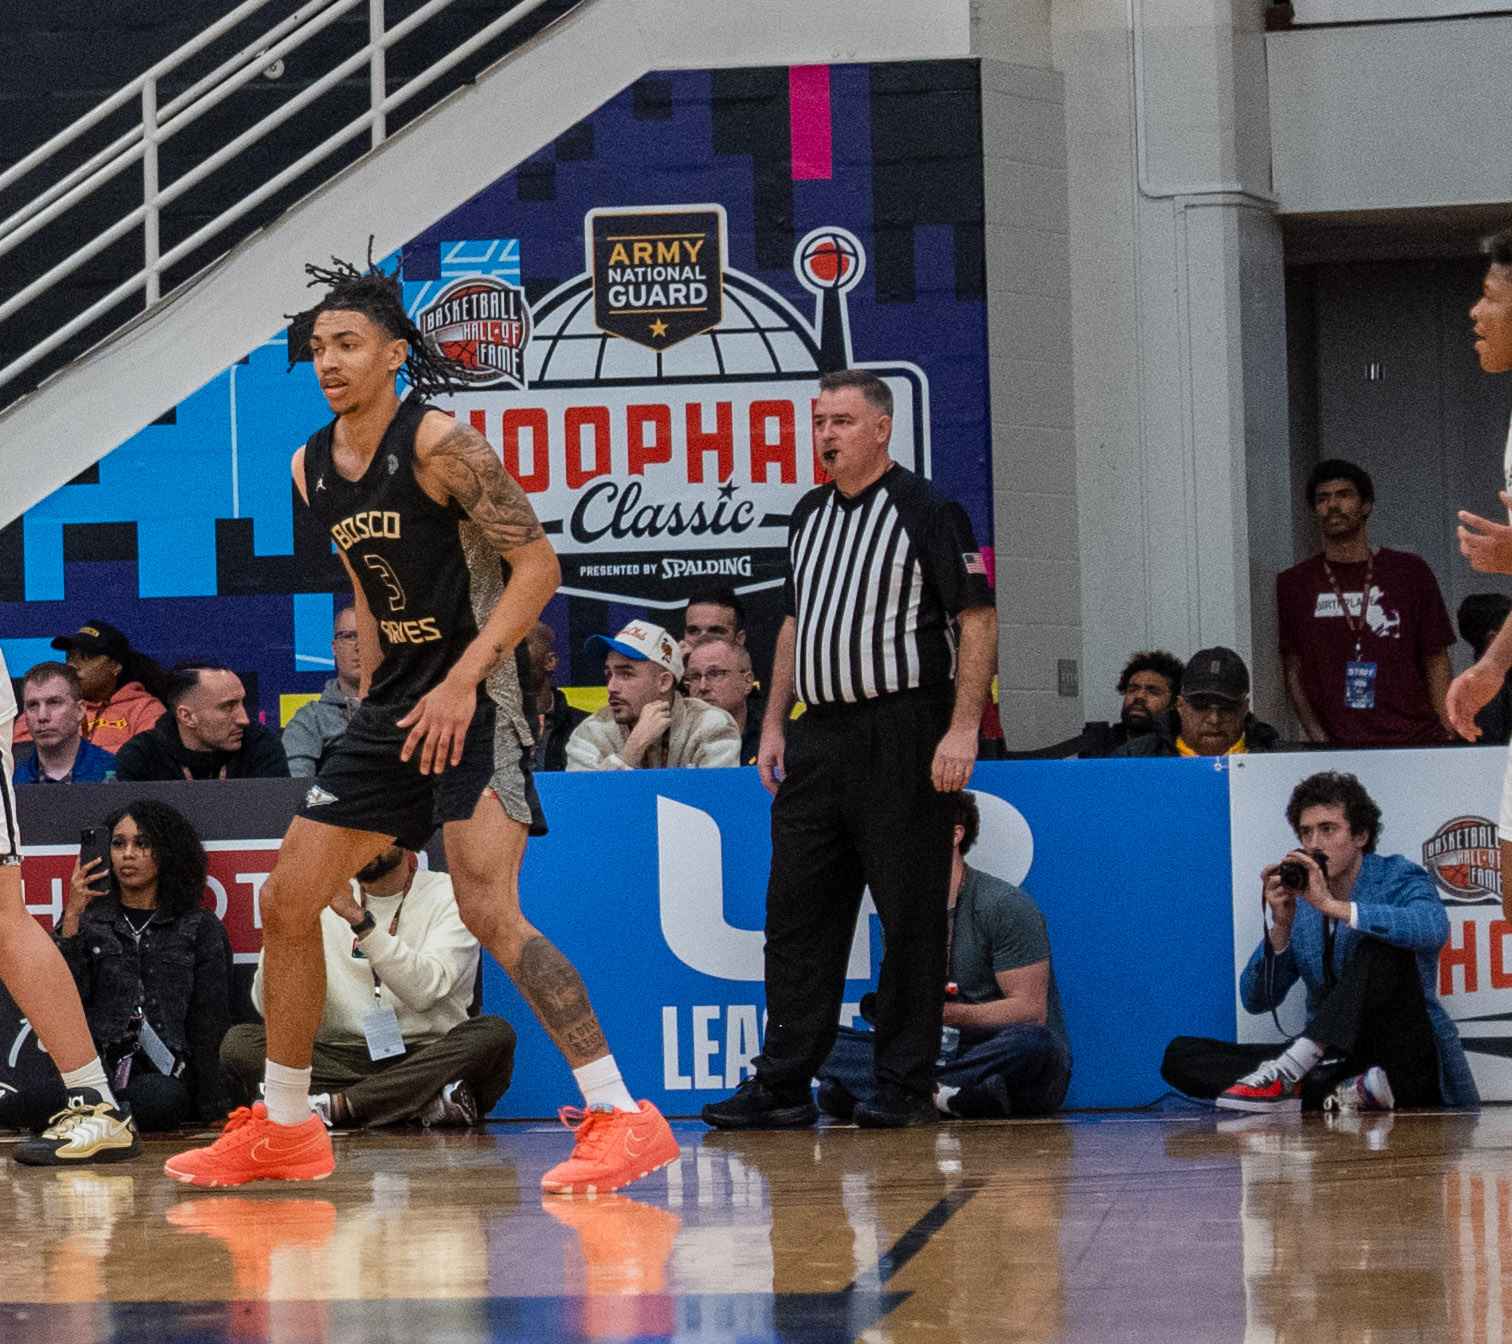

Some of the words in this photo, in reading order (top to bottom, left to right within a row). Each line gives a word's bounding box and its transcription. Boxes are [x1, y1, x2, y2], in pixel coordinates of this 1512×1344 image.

[608, 238, 703, 268] ARMY
[607, 264, 707, 284] NATIONAL
[426, 291, 519, 331] BASKETBALL
[608, 282, 709, 308] GUARD
[464, 322, 495, 341] HALL
[501, 321, 521, 347] OF
[480, 343, 521, 380] FAME
[570, 479, 754, 545] Classic
[331, 510, 401, 551] BOSCO
[363, 554, 407, 612] 3
[579, 564, 640, 577] PRESENTED
[642, 564, 658, 576] BY
[661, 556, 753, 579] SPALDING
